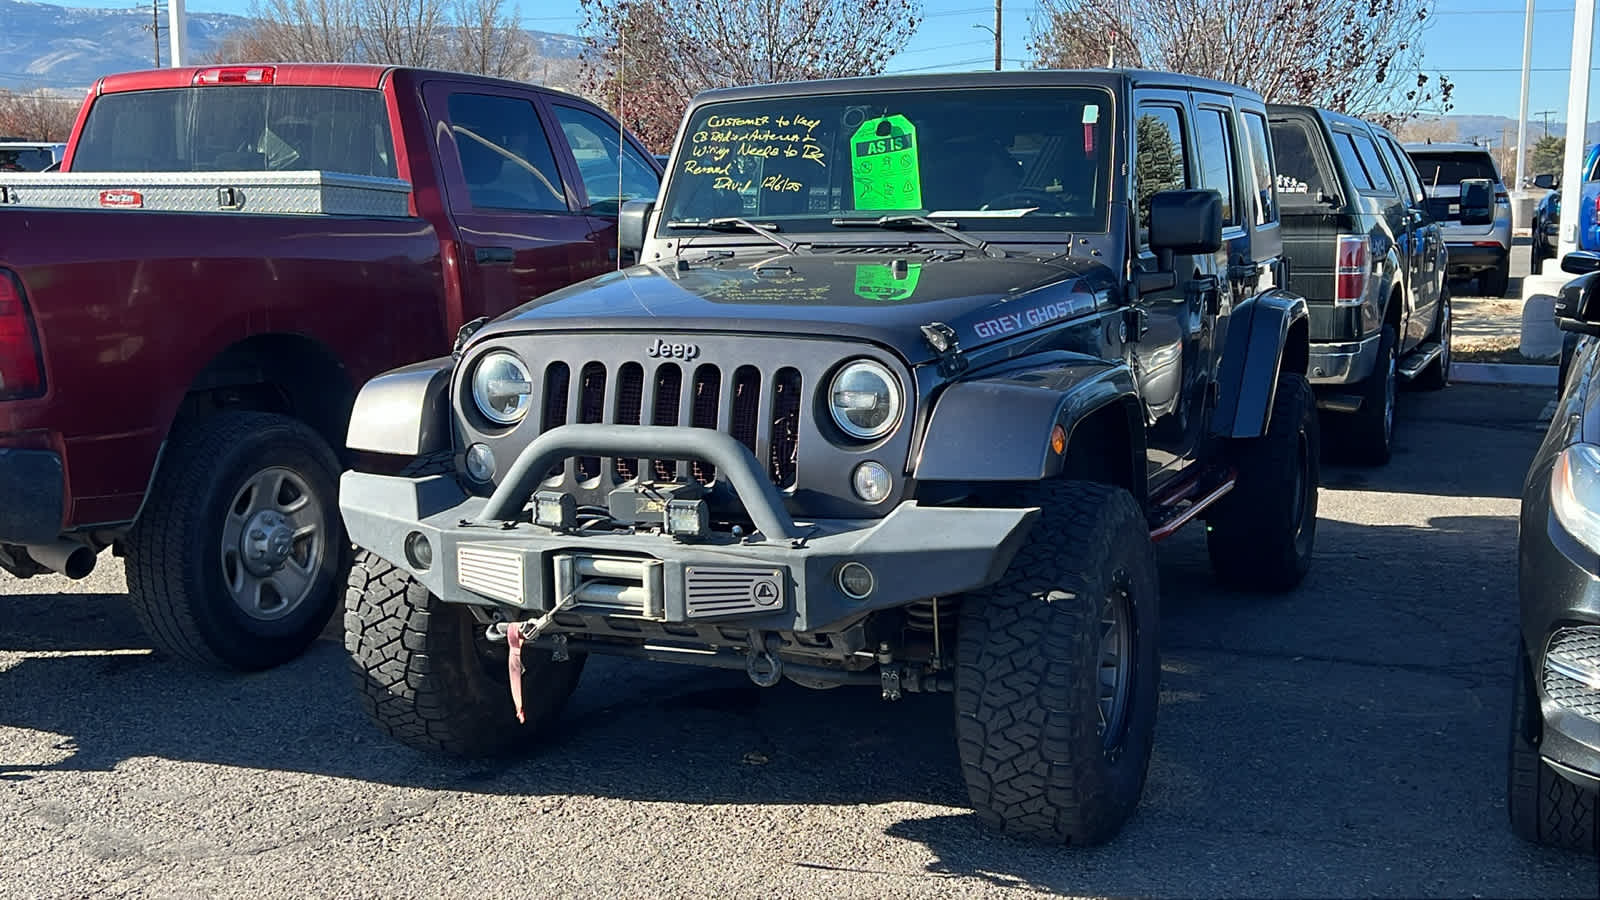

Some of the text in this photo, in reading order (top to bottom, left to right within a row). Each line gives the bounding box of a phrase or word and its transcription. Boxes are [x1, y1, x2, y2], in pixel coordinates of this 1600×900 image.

[692, 131, 709, 143] CB
[867, 137, 904, 155] AS IS
[692, 145, 730, 161] Wiring
[783, 144, 798, 158] to
[973, 299, 1075, 338] GREY GHOST
[646, 339, 700, 361] Jeep
